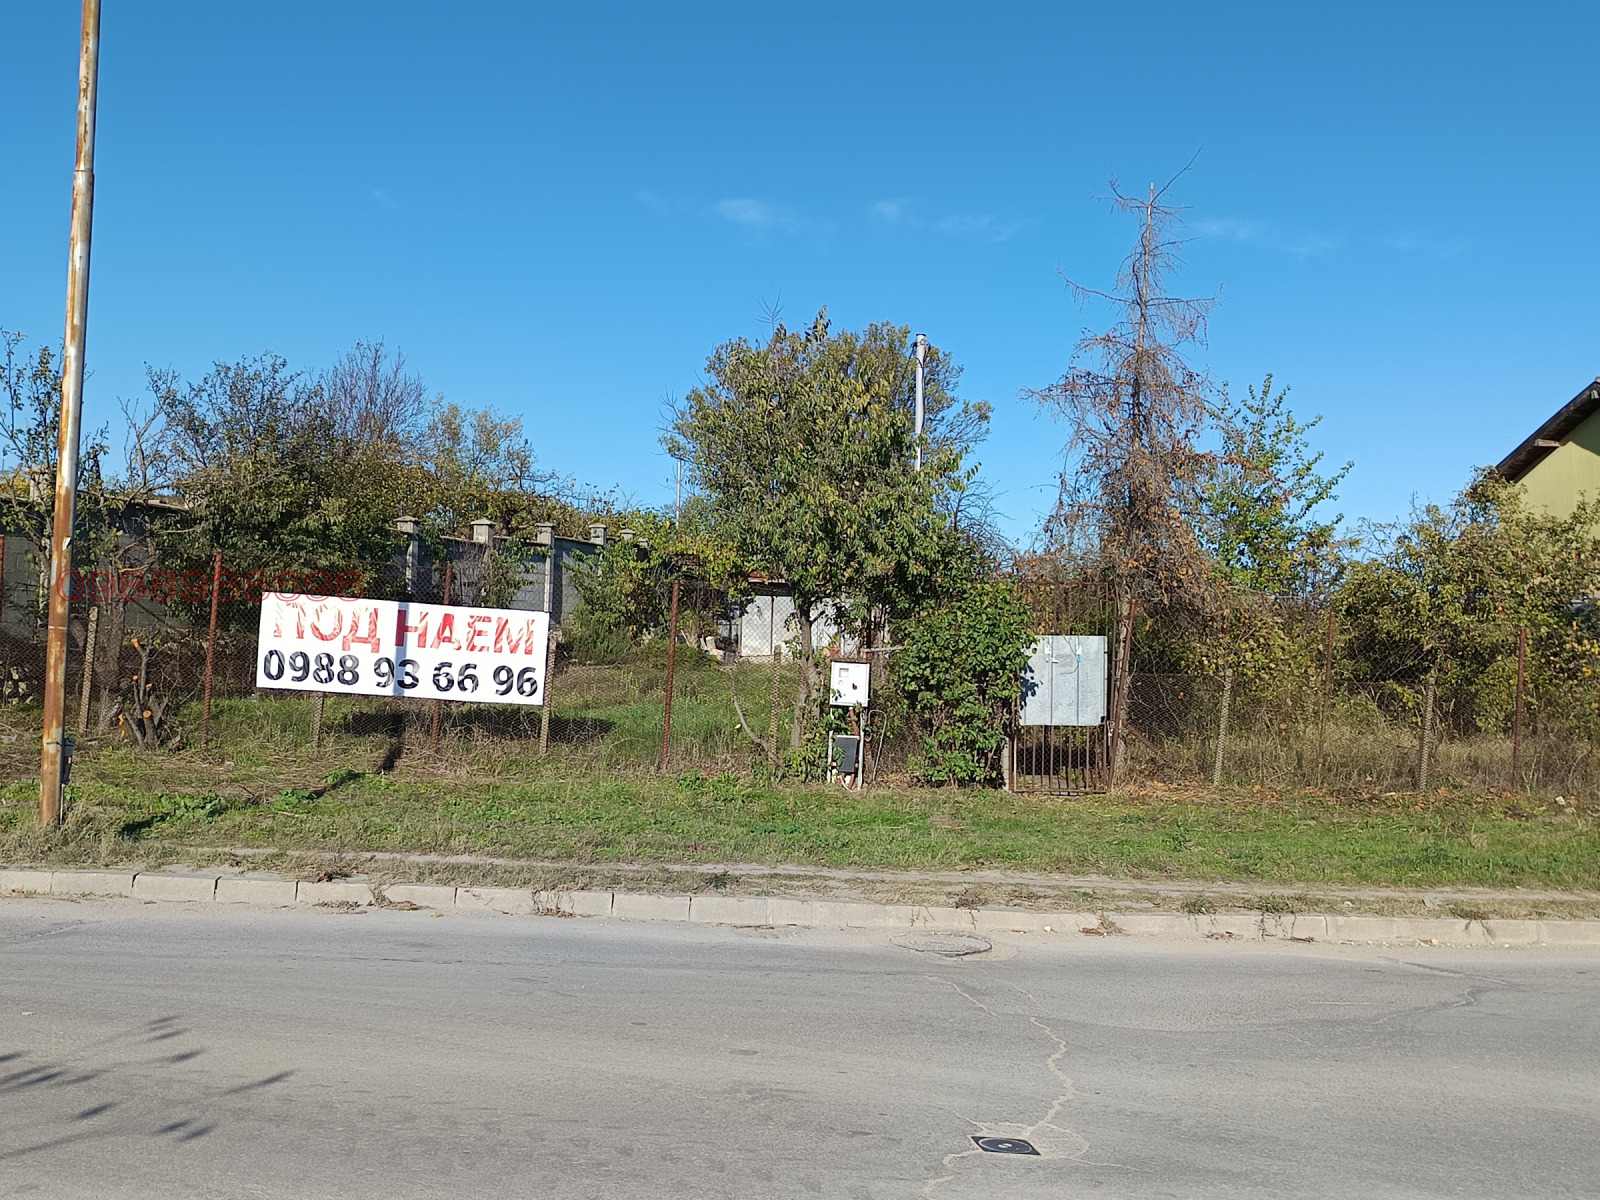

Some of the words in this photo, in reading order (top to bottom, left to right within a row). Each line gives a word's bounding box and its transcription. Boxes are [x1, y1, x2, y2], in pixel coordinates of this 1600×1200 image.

[273, 600, 382, 655] ПОД
[394, 607, 536, 656] НАЕМ
[263, 648, 361, 686] 0988
[373, 656, 421, 690] 93
[432, 661, 480, 694] 66
[492, 664, 539, 698] 96
